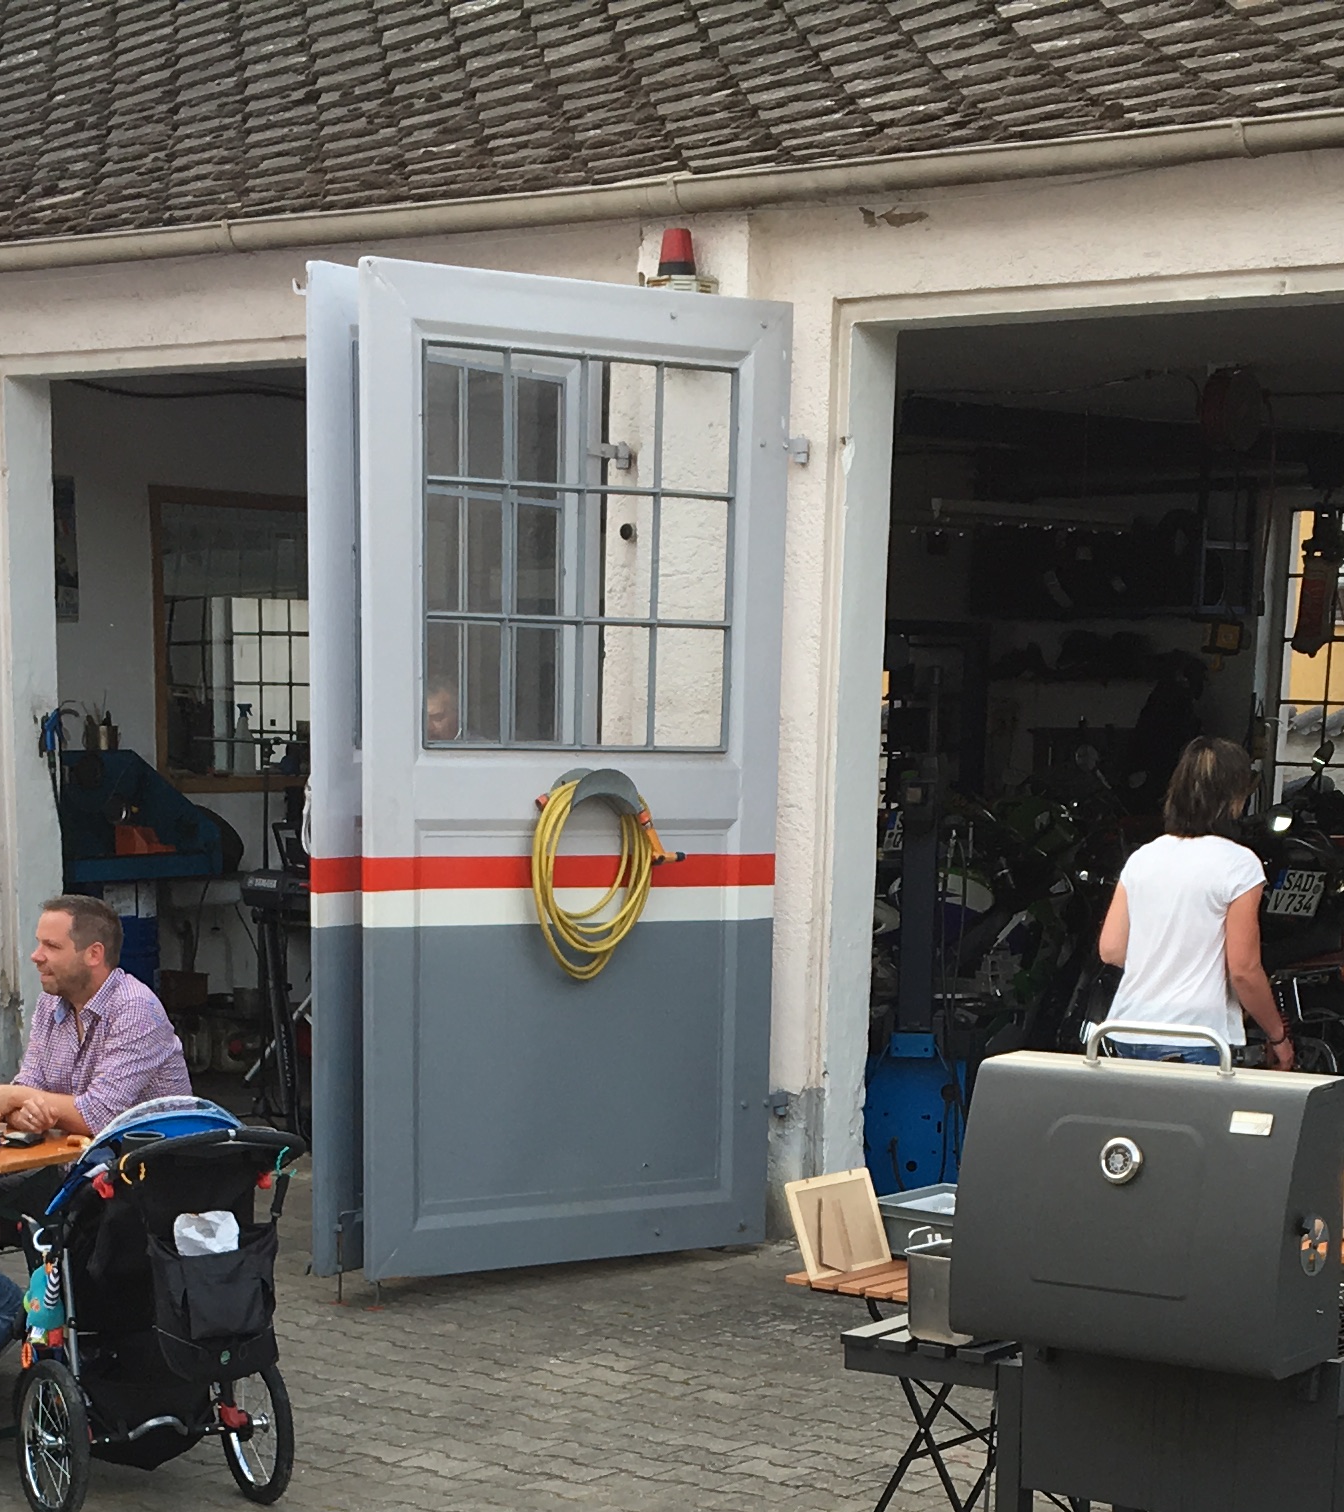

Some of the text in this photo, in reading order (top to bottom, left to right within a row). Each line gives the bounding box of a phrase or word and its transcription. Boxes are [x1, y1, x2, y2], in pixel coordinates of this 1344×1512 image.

[1283, 872, 1316, 892] SAD
[1273, 892, 1315, 914] V 734
